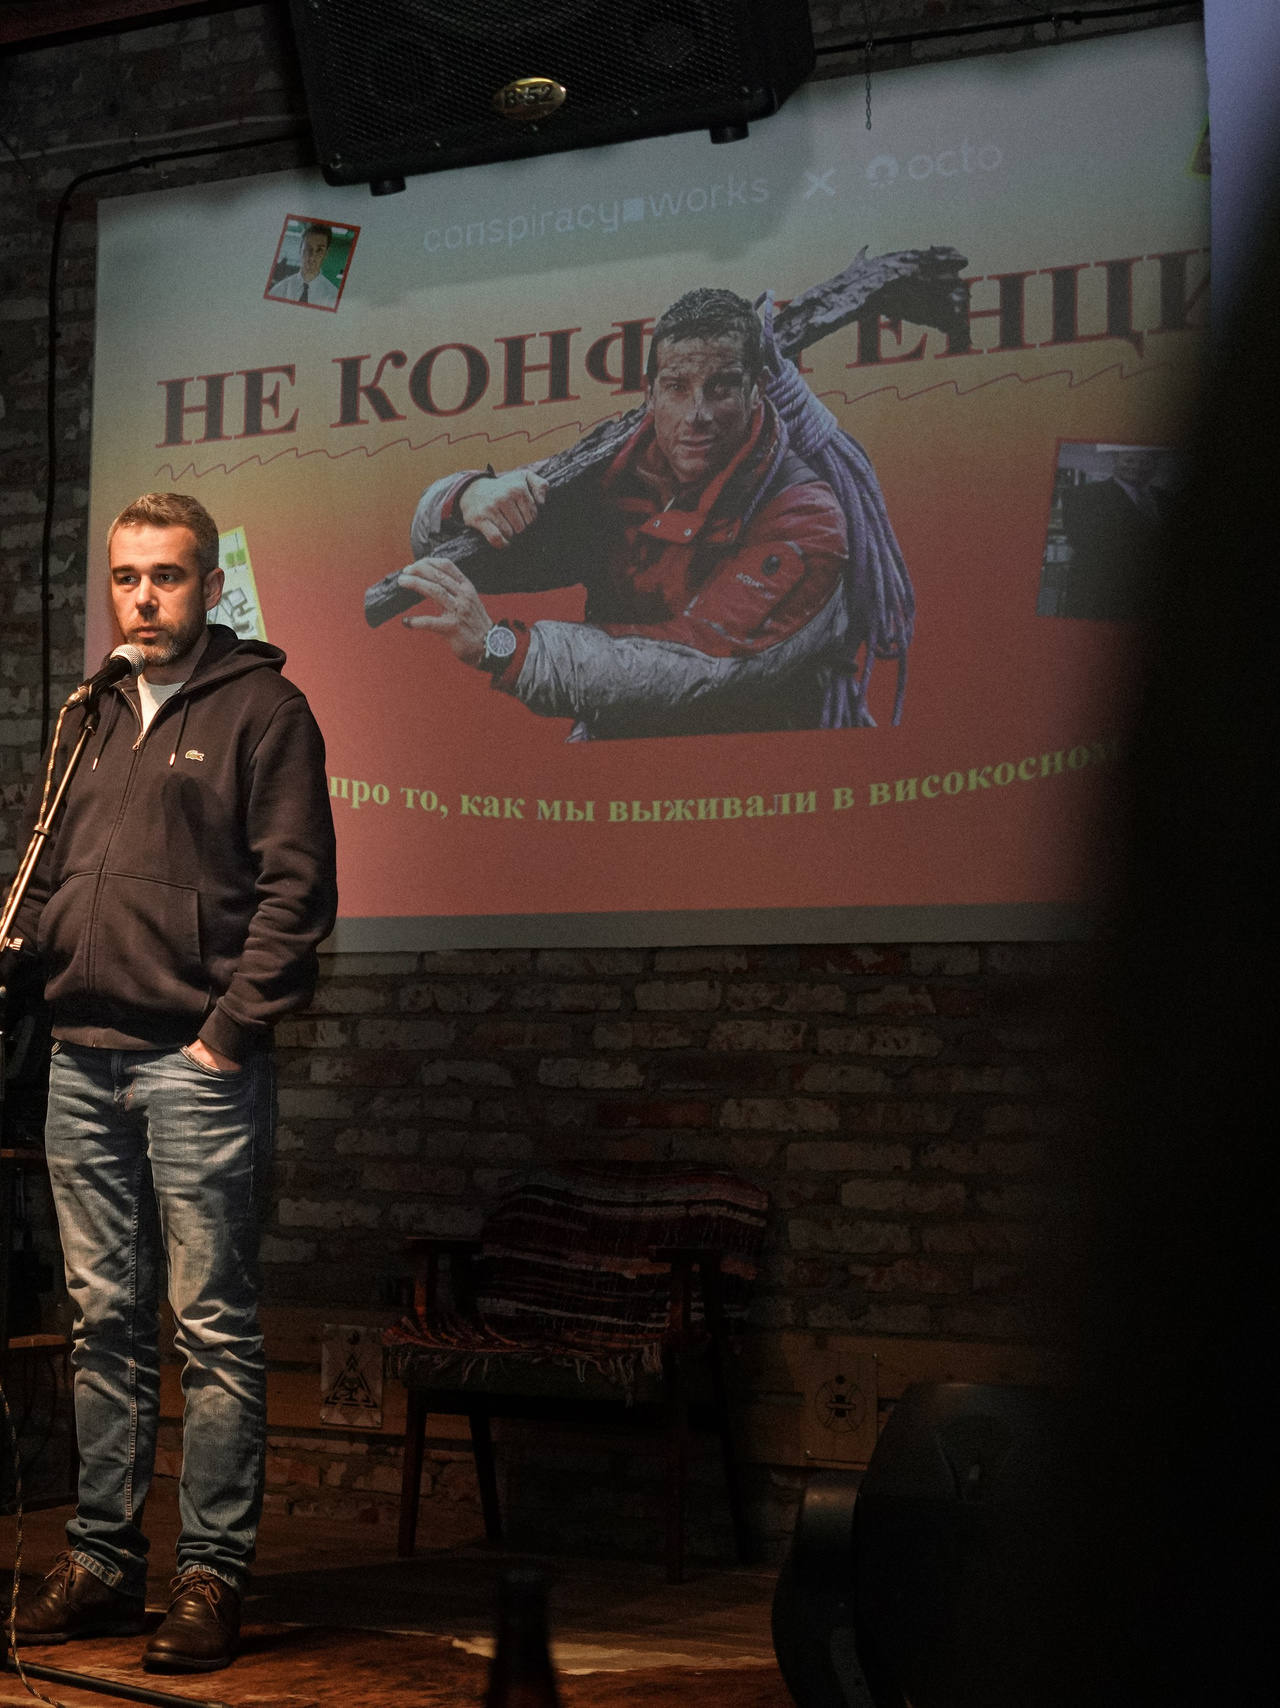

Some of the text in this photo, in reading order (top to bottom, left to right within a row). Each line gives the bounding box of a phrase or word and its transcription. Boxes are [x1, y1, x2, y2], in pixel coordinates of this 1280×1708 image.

[423, 202, 622, 253] conspiracy
[646, 174, 770, 220] works
[907, 138, 1004, 181] octo
[154, 363, 301, 449] НЕ
[328, 775, 391, 810] про
[399, 787, 450, 820] то,
[460, 793, 526, 820] как
[536, 799, 596, 822] мы
[607, 791, 818, 823] выживали
[832, 787, 856, 811] в
